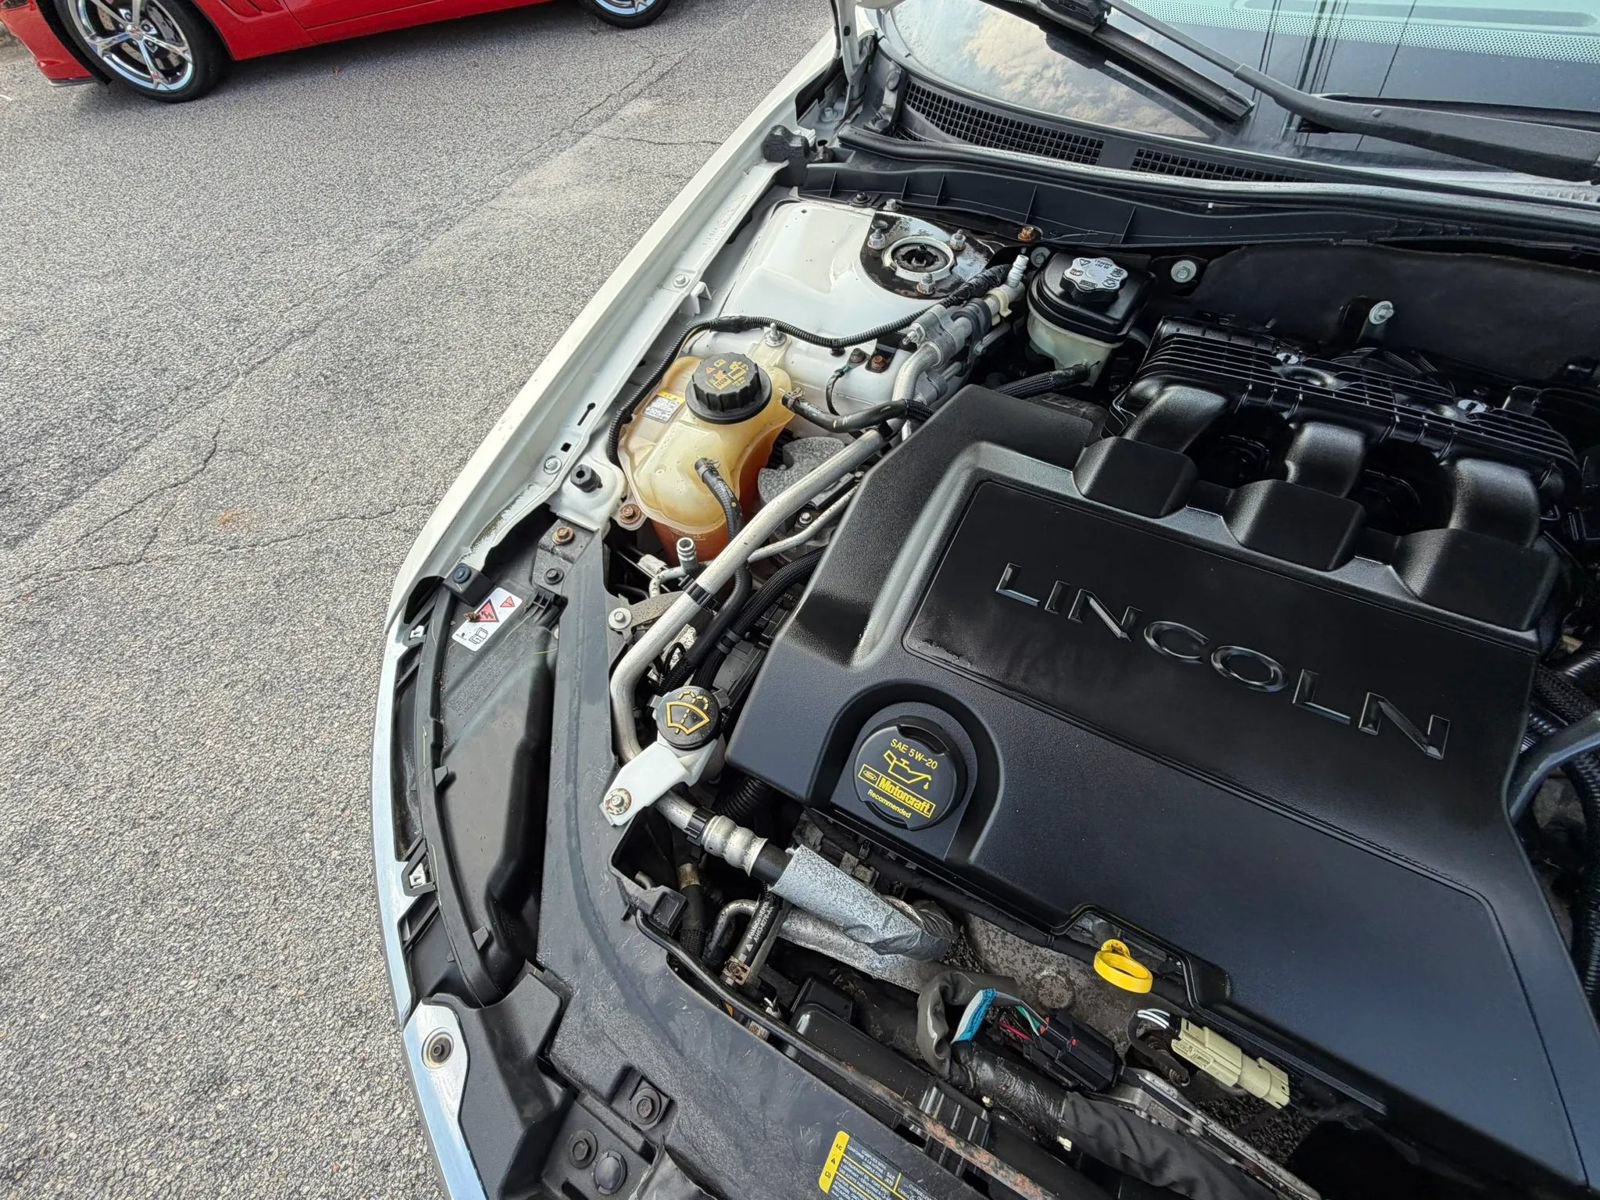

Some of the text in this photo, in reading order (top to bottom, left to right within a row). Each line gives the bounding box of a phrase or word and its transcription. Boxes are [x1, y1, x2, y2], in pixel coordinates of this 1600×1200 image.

[994, 561, 1451, 761] LINCOLN
[890, 739, 938, 770] SAE 5W-20
[867, 788, 912, 819] Recommended
